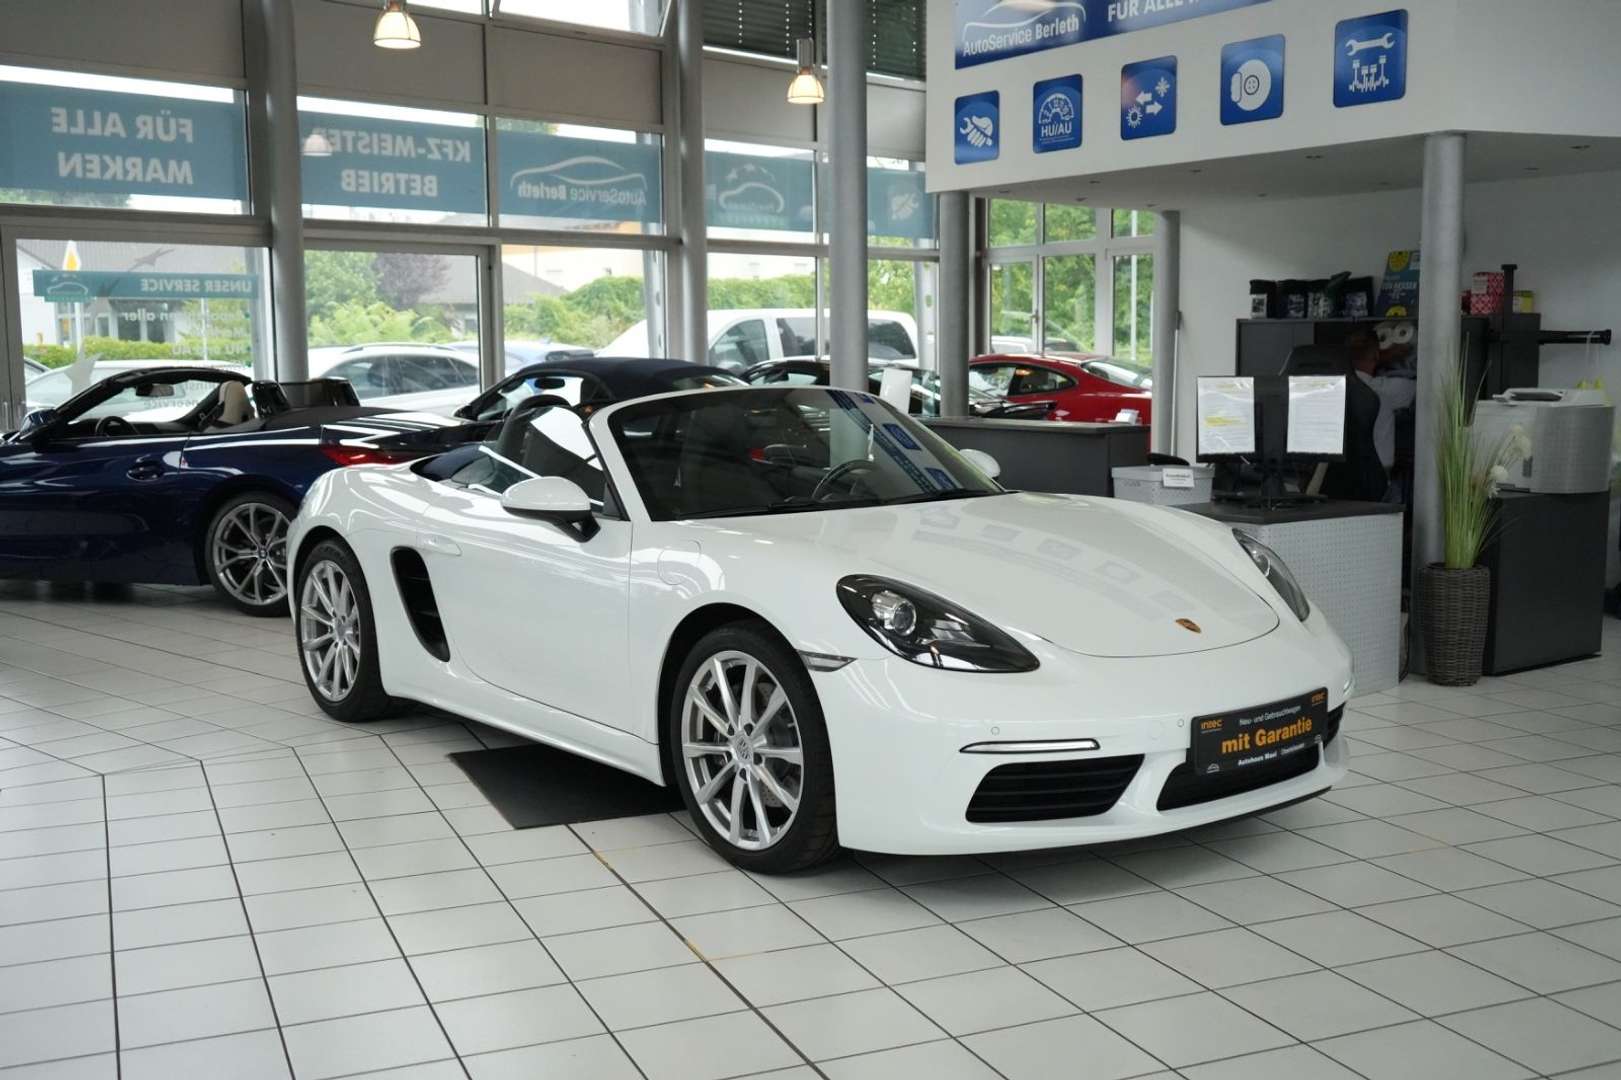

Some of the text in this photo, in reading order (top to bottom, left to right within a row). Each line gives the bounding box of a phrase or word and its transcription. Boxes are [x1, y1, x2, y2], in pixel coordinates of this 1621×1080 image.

[963, 14, 1079, 57] AutoService Berleth
[1041, 121, 1072, 138] HU/AU
[1221, 718, 1312, 755] mit Garantie
